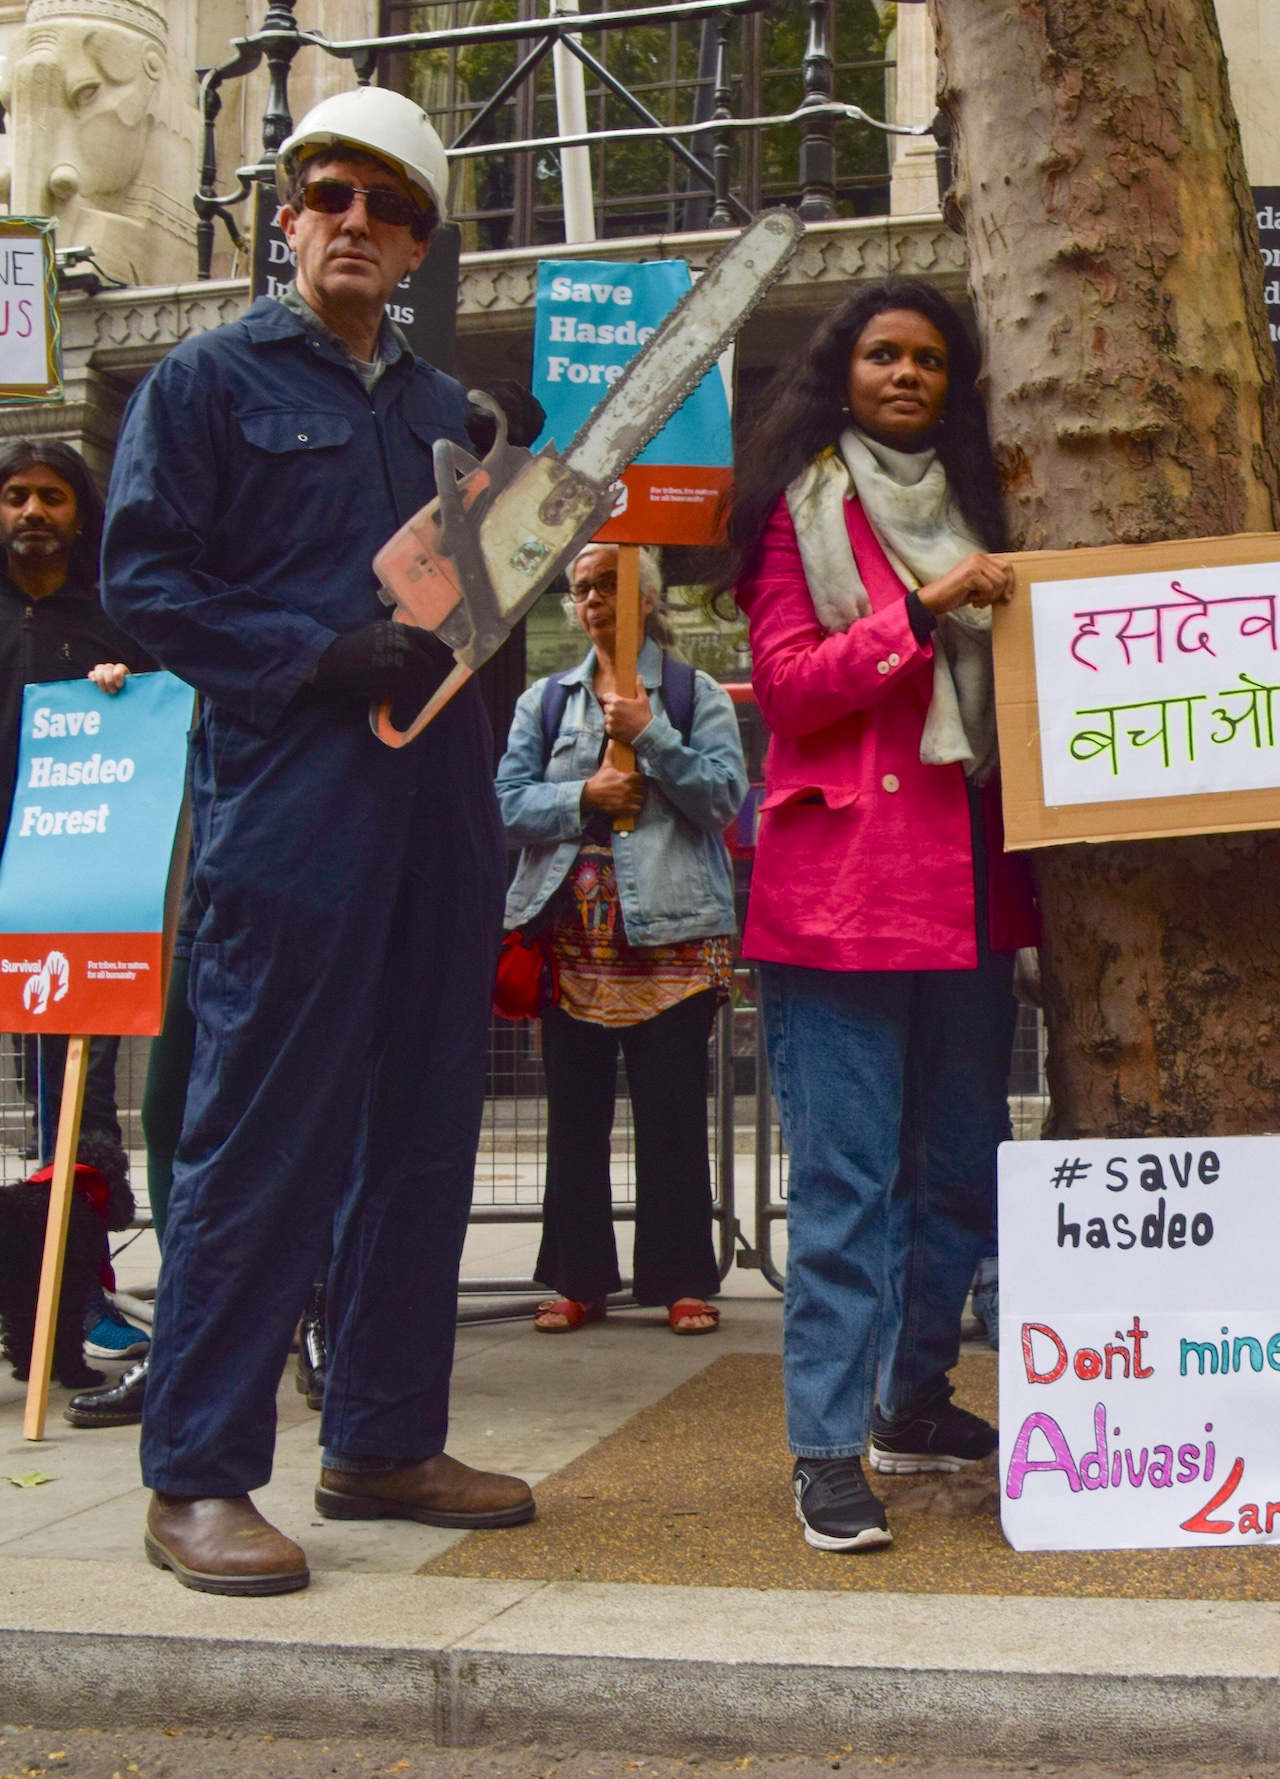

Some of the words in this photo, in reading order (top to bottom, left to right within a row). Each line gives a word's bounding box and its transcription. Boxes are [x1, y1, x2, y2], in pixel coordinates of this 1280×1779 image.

[550, 276, 633, 306] Save
[549, 316, 656, 346] Hasde
[546, 356, 626, 385] Fore
[1070, 580, 1280, 672] हसदेव
[31, 707, 101, 739] Save
[27, 753, 135, 789] Hasdeo
[18, 803, 110, 838] Forest
[1, 958, 42, 974] Survival
[1057, 1197, 1214, 1250] hasdeo
[1006, 1402, 1217, 1500] Adivasi
